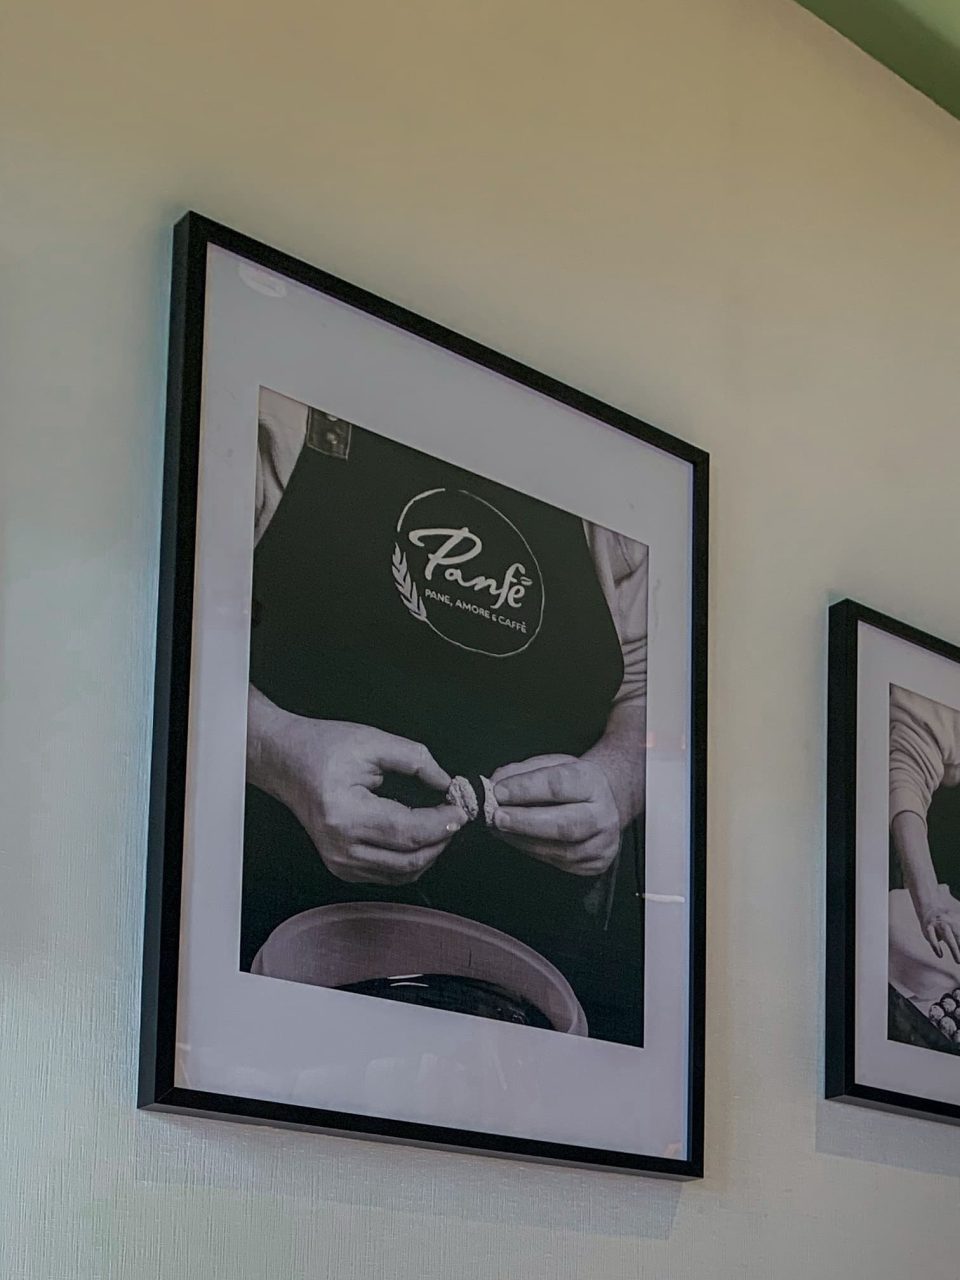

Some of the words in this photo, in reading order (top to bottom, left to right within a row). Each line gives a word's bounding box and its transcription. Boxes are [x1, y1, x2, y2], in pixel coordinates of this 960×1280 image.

[424, 588, 453, 606] PANE,
[455, 599, 490, 619] AMORE
[498, 615, 527, 634] CAFFÈ
